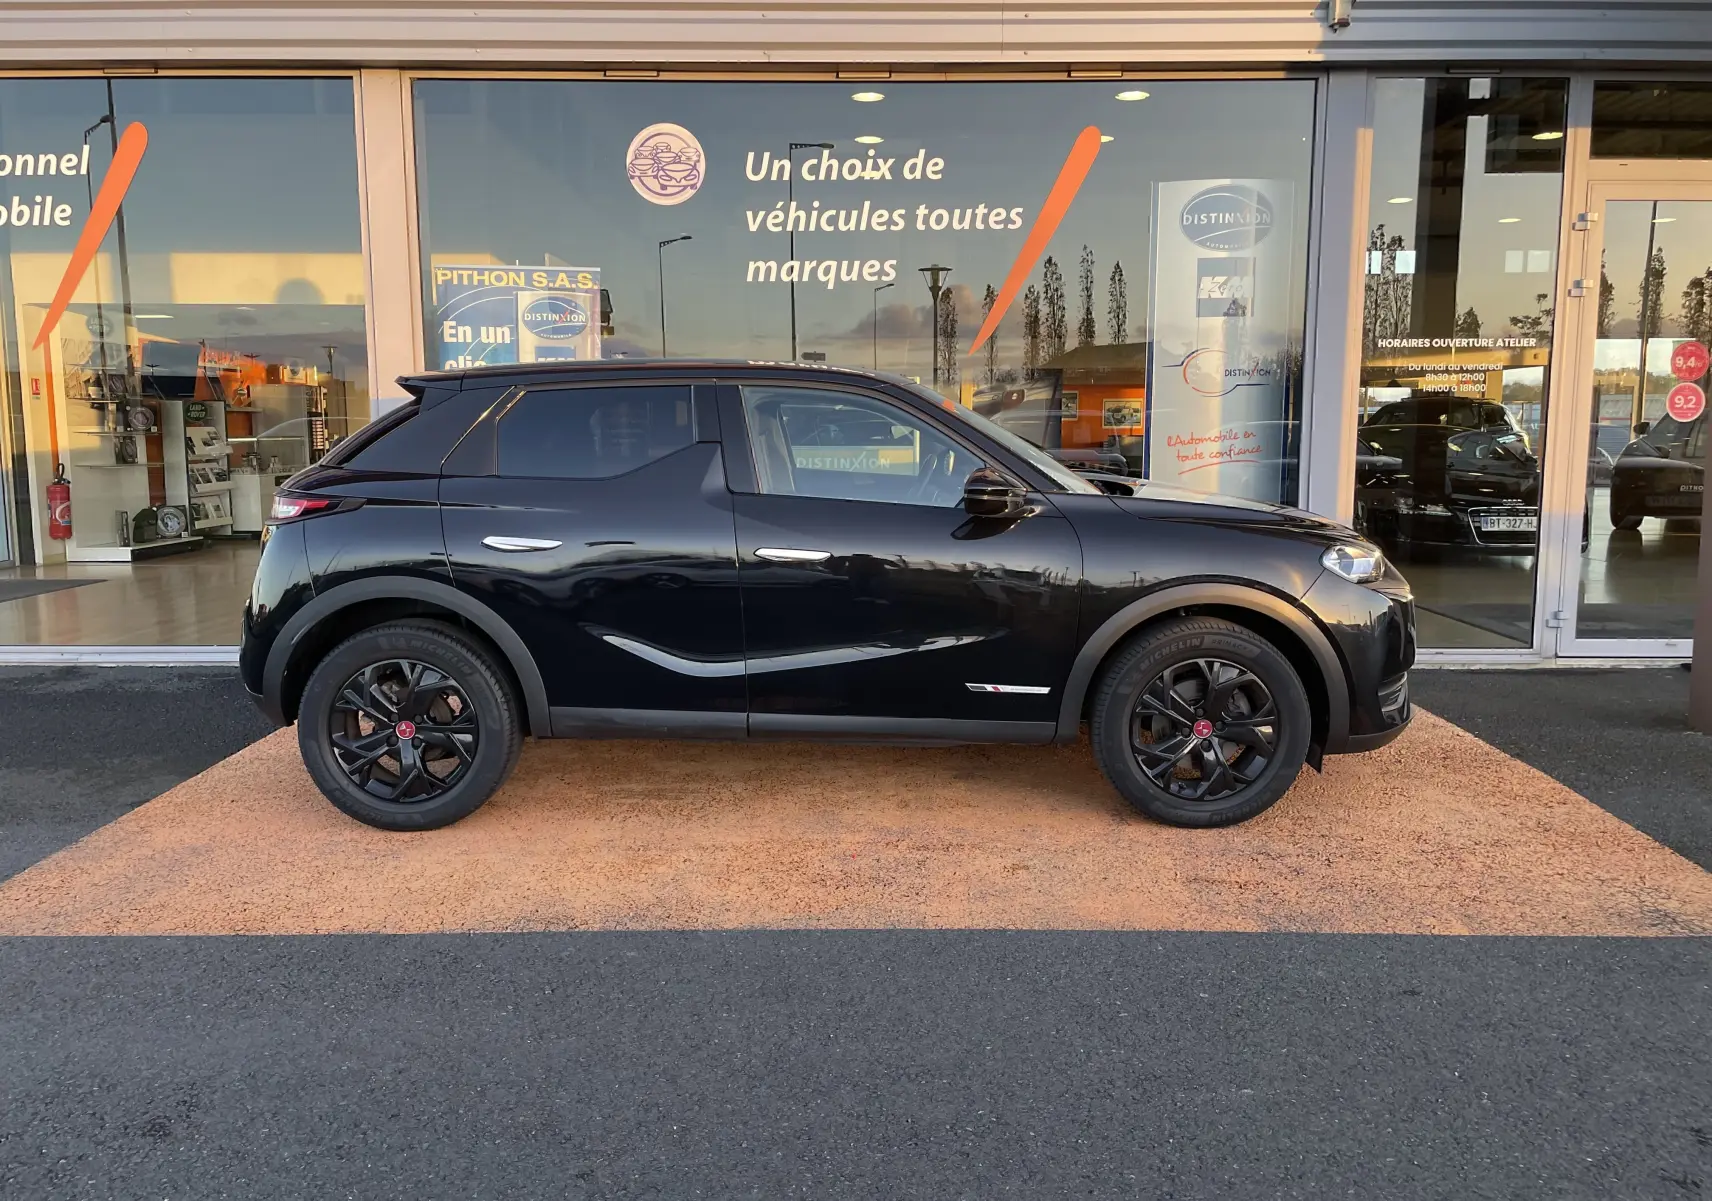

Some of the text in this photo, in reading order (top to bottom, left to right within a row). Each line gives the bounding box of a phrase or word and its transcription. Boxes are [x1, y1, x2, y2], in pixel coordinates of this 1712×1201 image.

[0, 144, 90, 176] onnel
[745, 149, 945, 182] Un choix de
[745, 200, 1024, 232] véhicules toutes
[436, 269, 599, 289] PITHON S.A.S.
[746, 258, 898, 290] marques
[524, 312, 586, 323] DISTINXION
[443, 321, 511, 344] En un
[1377, 338, 1537, 348] HORAIRES OUVERTURE ATELIER
[1408, 363, 1421, 371] Du
[1422, 363, 1447, 371] lundi
[1461, 362, 1504, 371] vendredi
[1425, 373, 1449, 381] 8h30
[1459, 373, 1485, 381] 12h00
[1423, 384, 1450, 392] 14h00
[1460, 384, 1486, 392] 18h00
[1243, 430, 1257, 439] en
[796, 453, 890, 471] DISTINXION
[1176, 444, 1263, 462] toute confiance
[1489, 518, 1538, 529] BT-327-H
[409, 638, 474, 675] MICHELIN
[1139, 636, 1204, 671] MICHELIN
